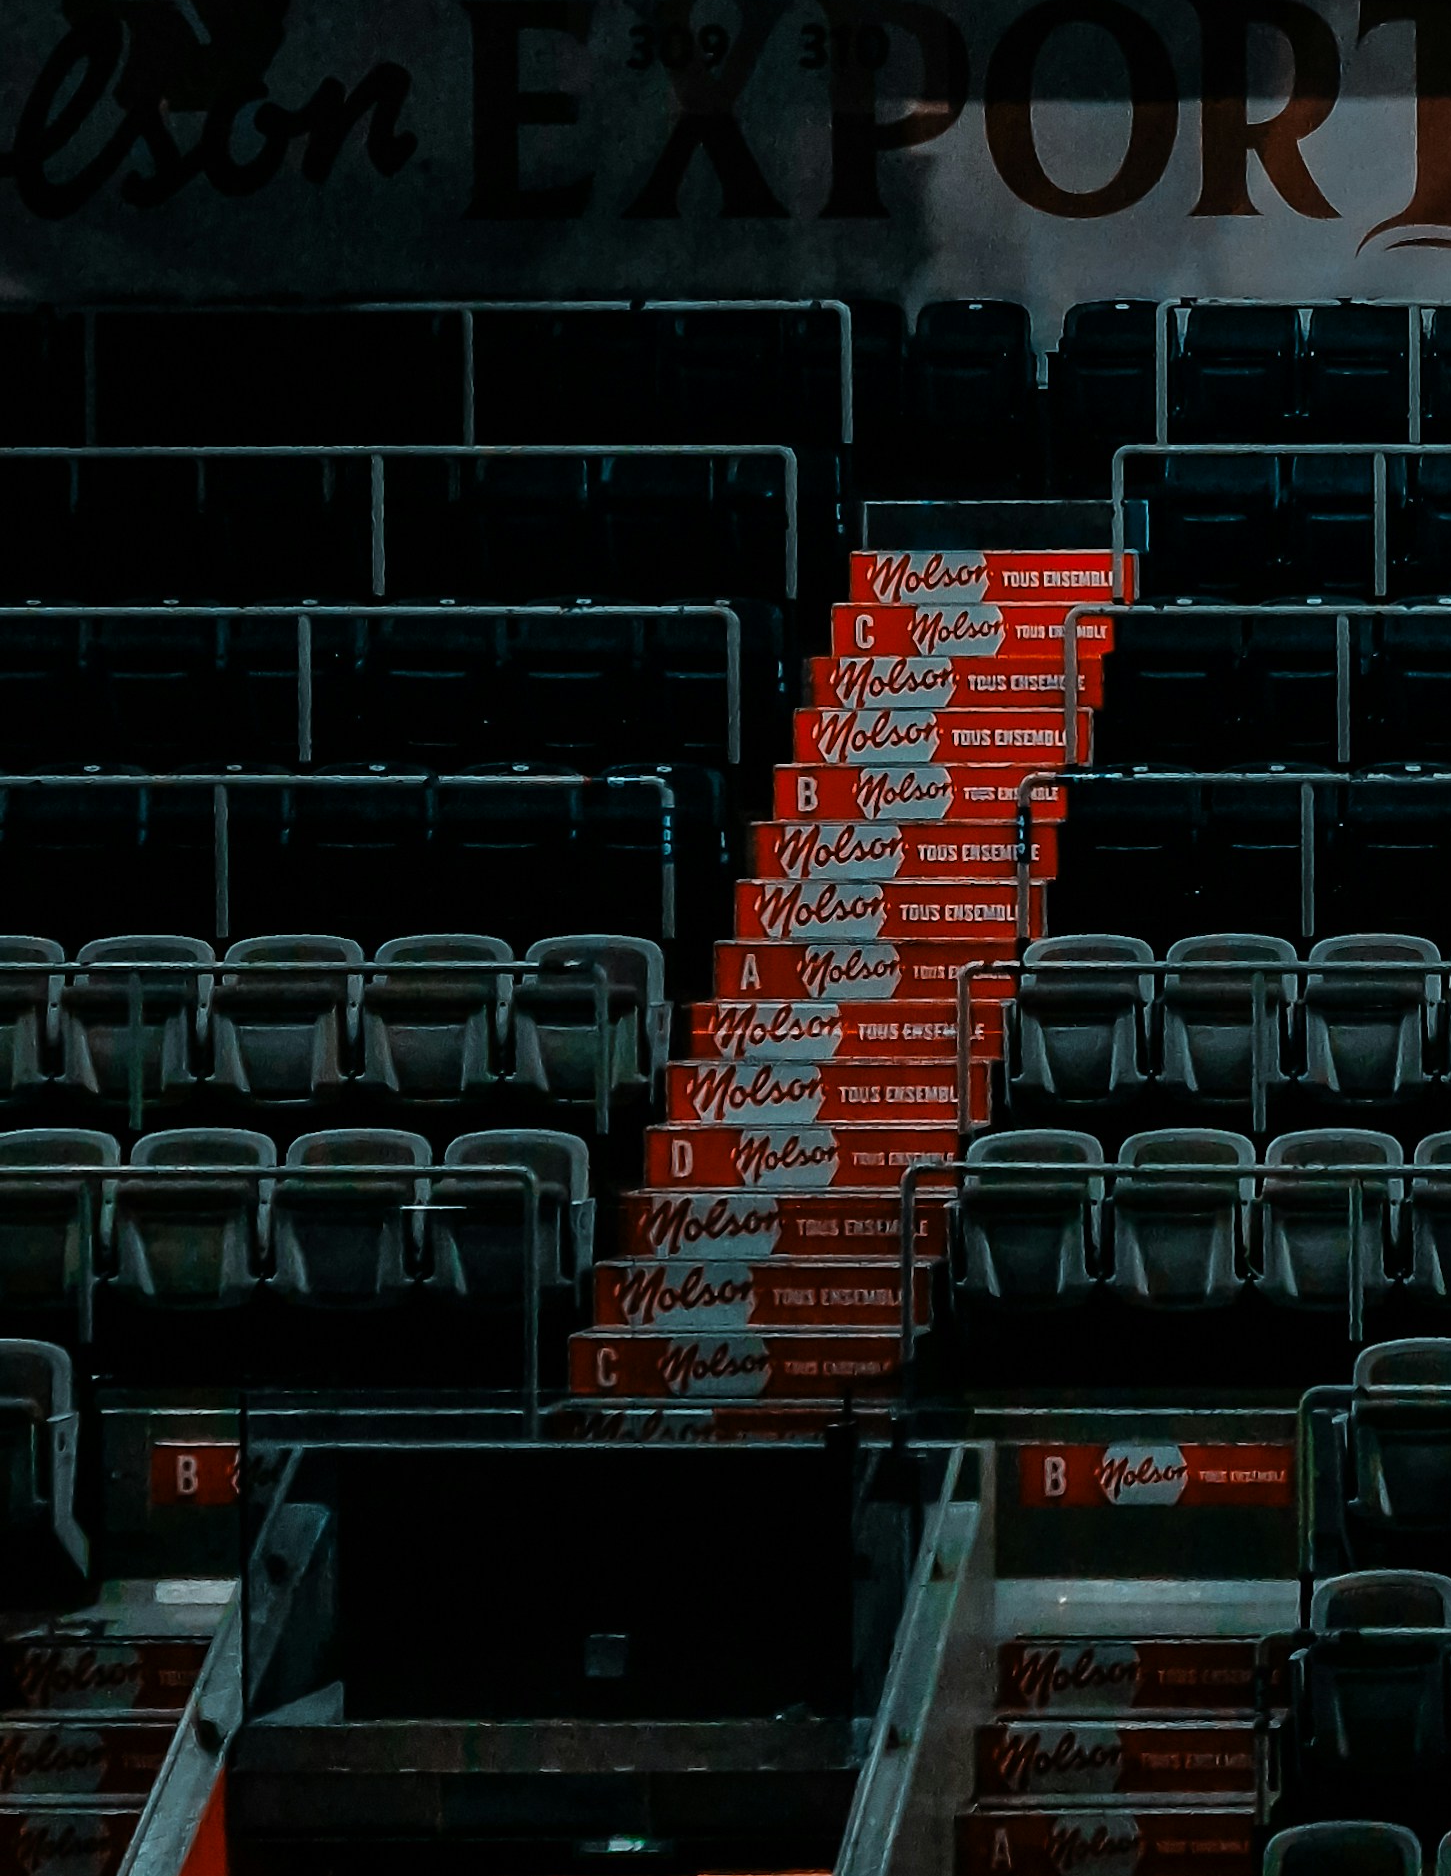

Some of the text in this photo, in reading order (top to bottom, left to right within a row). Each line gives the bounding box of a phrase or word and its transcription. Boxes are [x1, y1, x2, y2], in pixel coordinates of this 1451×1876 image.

[627, 22, 732, 72] 309
[799, 21, 890, 72] 310
[866, 553, 1113, 602] Molson TOUS ENSEMBL
[855, 613, 875, 650] C
[908, 613, 1004, 654] Molson
[830, 658, 1006, 708] Molson TOUS
[812, 710, 1066, 763] Molson TOUS ENSEMBL
[797, 775, 819, 813] B
[852, 774, 955, 818] Molson
[775, 825, 957, 879] Molson TOUS
[754, 883, 1018, 939] Molson TOUS ENSEMBL
[740, 954, 761, 991] A
[797, 949, 905, 997] Molson
[705, 1004, 844, 1059] Molson
[687, 1065, 957, 1121] Molson TOUS ENSEMBL
[671, 1138, 694, 1179] D
[731, 1135, 839, 1185] Molson
[639, 1197, 784, 1254] Molson
[614, 1266, 758, 1324] Molson
[821, 1289, 902, 1307] ENSEMBL
[596, 1346, 620, 1389] C
[658, 1345, 773, 1393] Molson
[176, 1453, 199, 1496] B
[1043, 1455, 1068, 1498] B
[1095, 1456, 1191, 1500] Molson
[989, 1826, 1013, 1871] A
